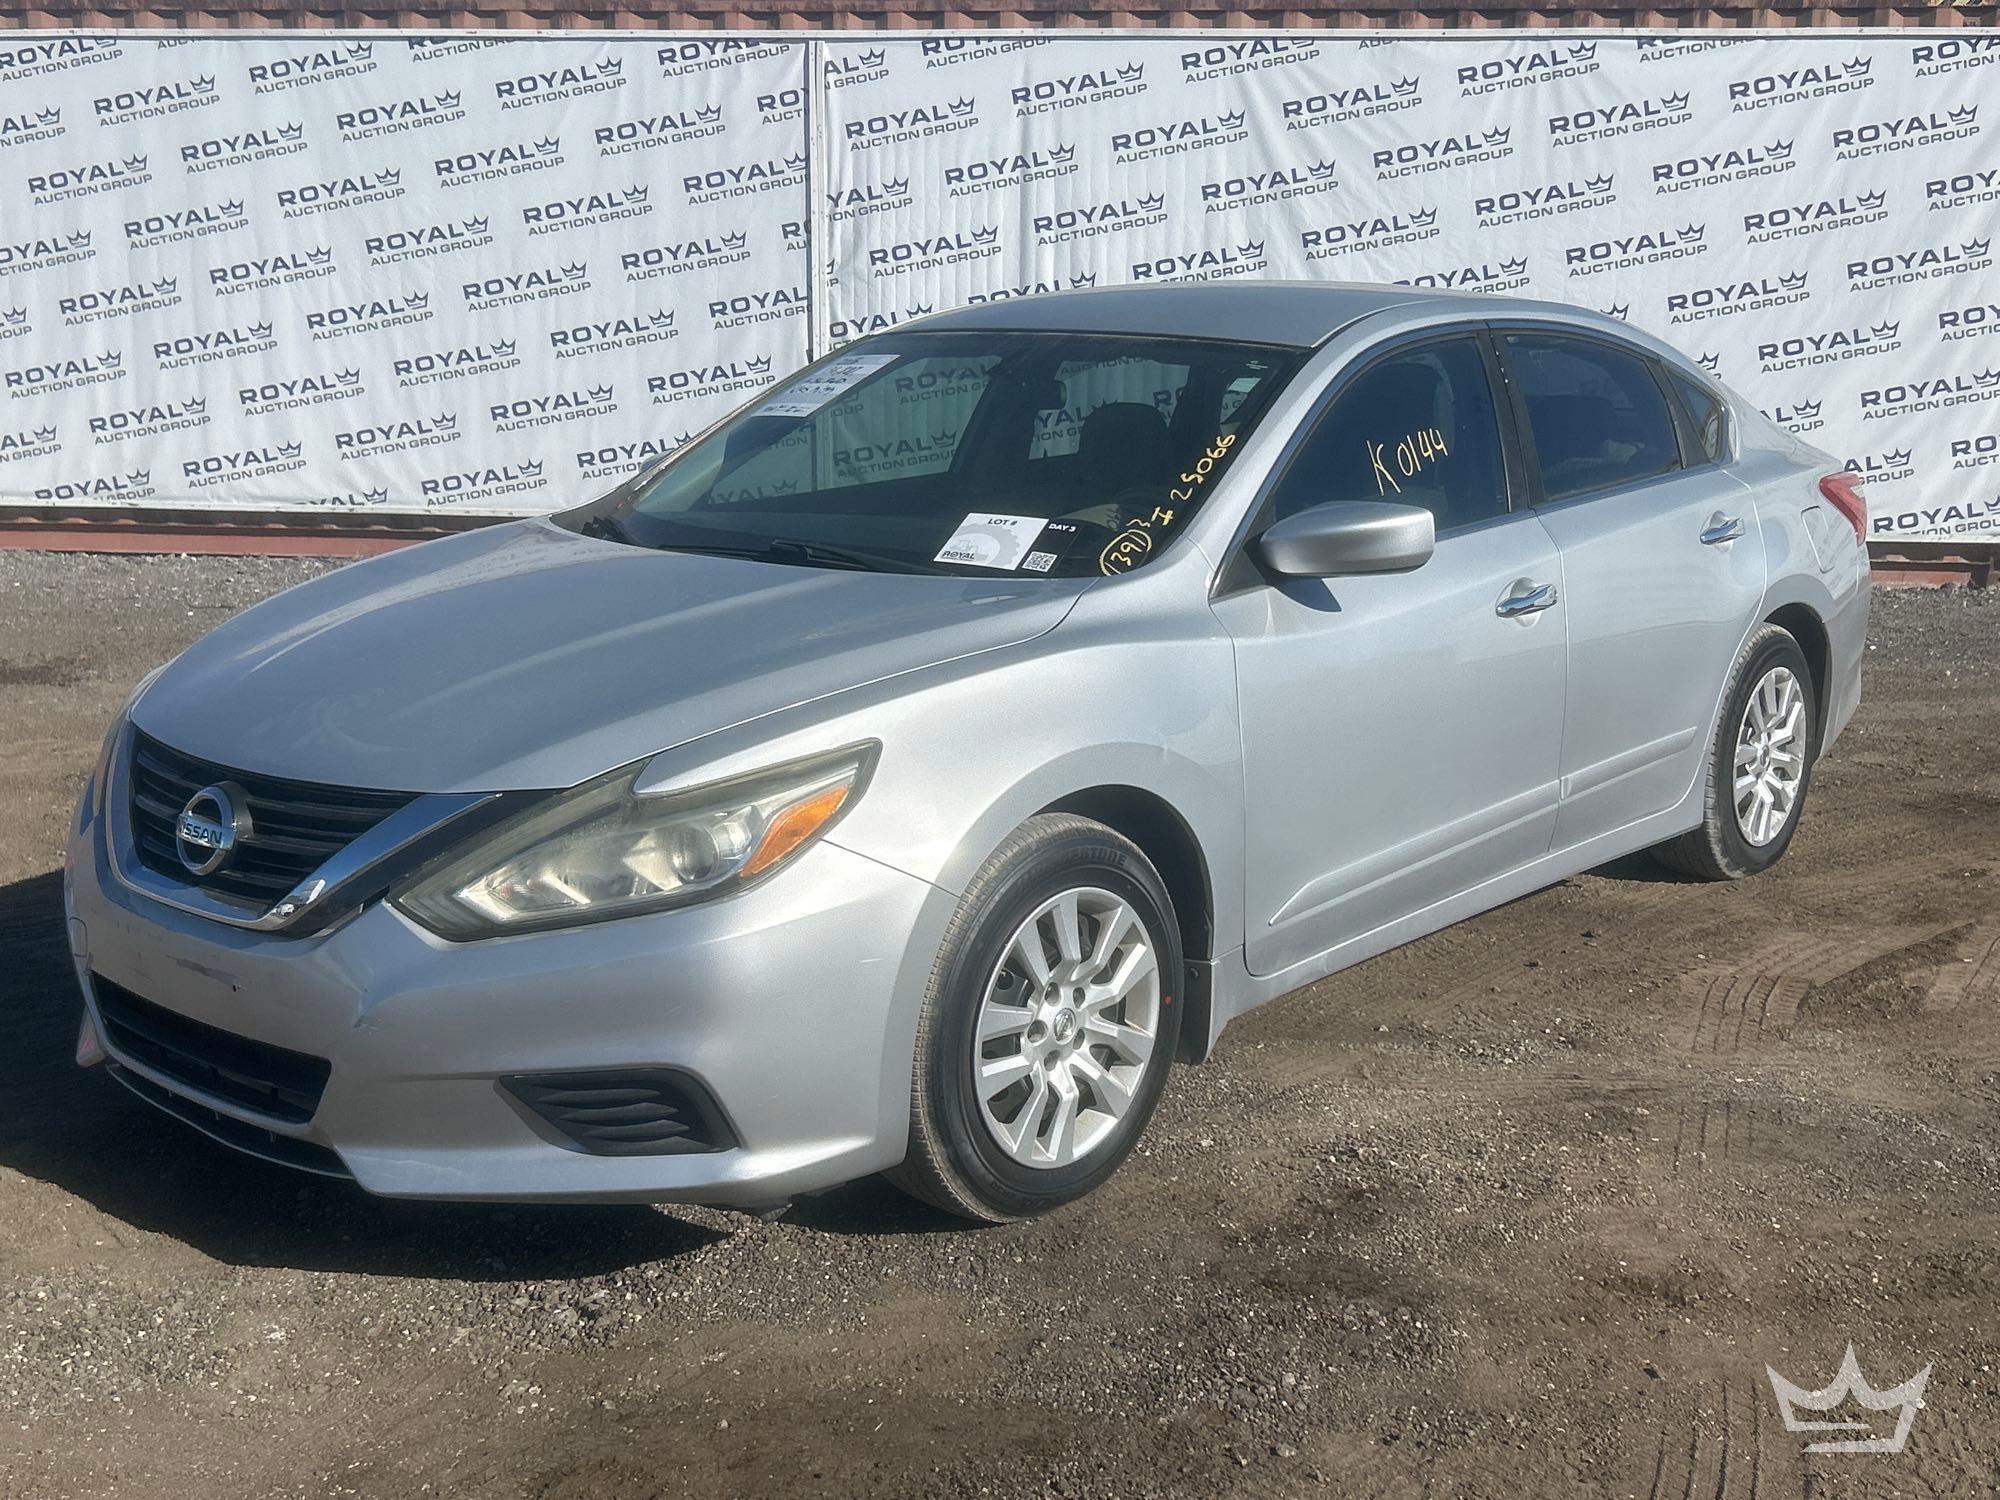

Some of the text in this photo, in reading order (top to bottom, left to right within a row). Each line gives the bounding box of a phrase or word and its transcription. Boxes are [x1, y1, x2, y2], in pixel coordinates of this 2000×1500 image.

[248, 49, 348, 83] ROYAL
[254, 61, 377, 95] AUCTION GROUP
[494, 65, 598, 99] ROYAL
[1456, 49, 1568, 85] ROYAL
[1460, 62, 1600, 98] AUCTION GROUP
[1728, 64, 1842, 100] ROYAL
[92, 82, 192, 115] ROYAL
[500, 77, 627, 111] AUCTION GROUP
[1010, 70, 1117, 105] ROYAL
[1015, 83, 1148, 119] AUCTION GROUP
[1282, 84, 1392, 119] ROYAL
[1732, 77, 1874, 113] AUCTION GROUP
[100, 94, 220, 127] AUCTION GROUP
[336, 97, 437, 130] ROYAL
[342, 109, 466, 143] AUCTION GROUP
[844, 105, 949, 140] ROYAL
[1286, 96, 1422, 131] AUCTION GROUP
[1548, 99, 1661, 135] ROYAL
[594, 111, 697, 145] ROYAL
[600, 124, 726, 157] AUCTION GROUP
[850, 117, 979, 152] AUCTION GROUP
[1111, 117, 1218, 152] ROYAL
[1552, 112, 1692, 148] AUCTION GROUP
[1832, 112, 1948, 148] ROYAL
[1835, 125, 1980, 161] AUCTION GROUP
[180, 129, 279, 162] ROYAL
[186, 141, 308, 174] AUCTION GROUP
[434, 143, 536, 176] ROYAL
[1115, 130, 1248, 165] AUCTION GROUP
[1372, 134, 1482, 169] ROYAL
[27, 161, 125, 193] ROYAL
[440, 155, 564, 189] AUCTION GROUP
[944, 151, 1049, 186] ROYAL
[948, 163, 1078, 198] AUCTION GROUP
[1376, 146, 1514, 181] AUCTION GROUP
[1652, 147, 1764, 182] ROYAL
[1655, 160, 1796, 195] AUCTION GROUP
[33, 173, 152, 206] AUCTION GROUP
[276, 175, 376, 207] ROYAL
[283, 187, 406, 219] AUCTION GROUP
[1474, 181, 1585, 216] ROYAL
[123, 206, 220, 238] ROYAL
[1032, 200, 1138, 234] ROYAL
[1478, 194, 1616, 229] AUCTION GROUP
[1743, 197, 1856, 232] ROYAL
[1746, 210, 1888, 245] AUCTION GROUP
[129, 218, 249, 250] AUCTION GROUP
[364, 223, 465, 255] ROYAL
[1037, 212, 1168, 247] AUCTION GROUP
[1300, 214, 1410, 251] ROYAL
[1304, 227, 1440, 261] AUCTION GROUP
[370, 235, 493, 267] AUCTION GROUP
[620, 238, 722, 270] ROYAL
[868, 232, 972, 267] ROYAL
[873, 245, 1002, 279] AUCTION GROUP
[1565, 230, 1676, 265] ROYAL
[1568, 243, 1708, 278] AUCTION GROUP
[1846, 245, 1960, 280] ROYAL
[626, 250, 751, 283] AUCTION GROUP
[1849, 258, 1992, 293] AUCTION GROUP
[58, 283, 154, 315] ROYAL
[64, 295, 182, 326] AUCTION GROUP
[1666, 278, 1779, 312] ROYAL
[1670, 291, 1810, 325] AUCTION GROUP
[152, 328, 250, 359] ROYAL
[549, 316, 650, 348] ROYAL
[555, 328, 678, 359] AUCTION GROUP
[1757, 327, 1871, 361] ROYAL
[159, 340, 278, 370] AUCTION GROUP
[392, 345, 492, 376] ROYAL
[1760, 340, 1902, 374] AUCTION GROUP
[4, 357, 99, 388] ROYAL
[10, 369, 126, 399] AUCTION GROUP
[238, 374, 336, 405] ROYAL
[399, 357, 520, 388] AUCTION GROUP
[646, 362, 747, 393] ROYAL
[652, 384, 720, 405] AUCTION
[721, 374, 776, 392] GROUP
[88, 403, 184, 434] ROYAL
[244, 386, 365, 417] AUCTION GROUP
[489, 391, 589, 421] ROYAL
[495, 403, 618, 433] AUCTION GROUP
[94, 415, 211, 445] AUCTION GROUP
[334, 419, 433, 450] ROYAL
[340, 431, 461, 461] AUCTION GROUP
[182, 447, 278, 477] ROYAL
[832, 437, 933, 467] ROYAL
[188, 459, 307, 489] AUCTION GROUP
[420, 465, 519, 496] ROYAL
[426, 478, 548, 507] AUCTION GROUP
[987, 518, 1008, 526] LOT
[1049, 523, 1067, 532] DAY
[942, 551, 975, 560] ROYAL
